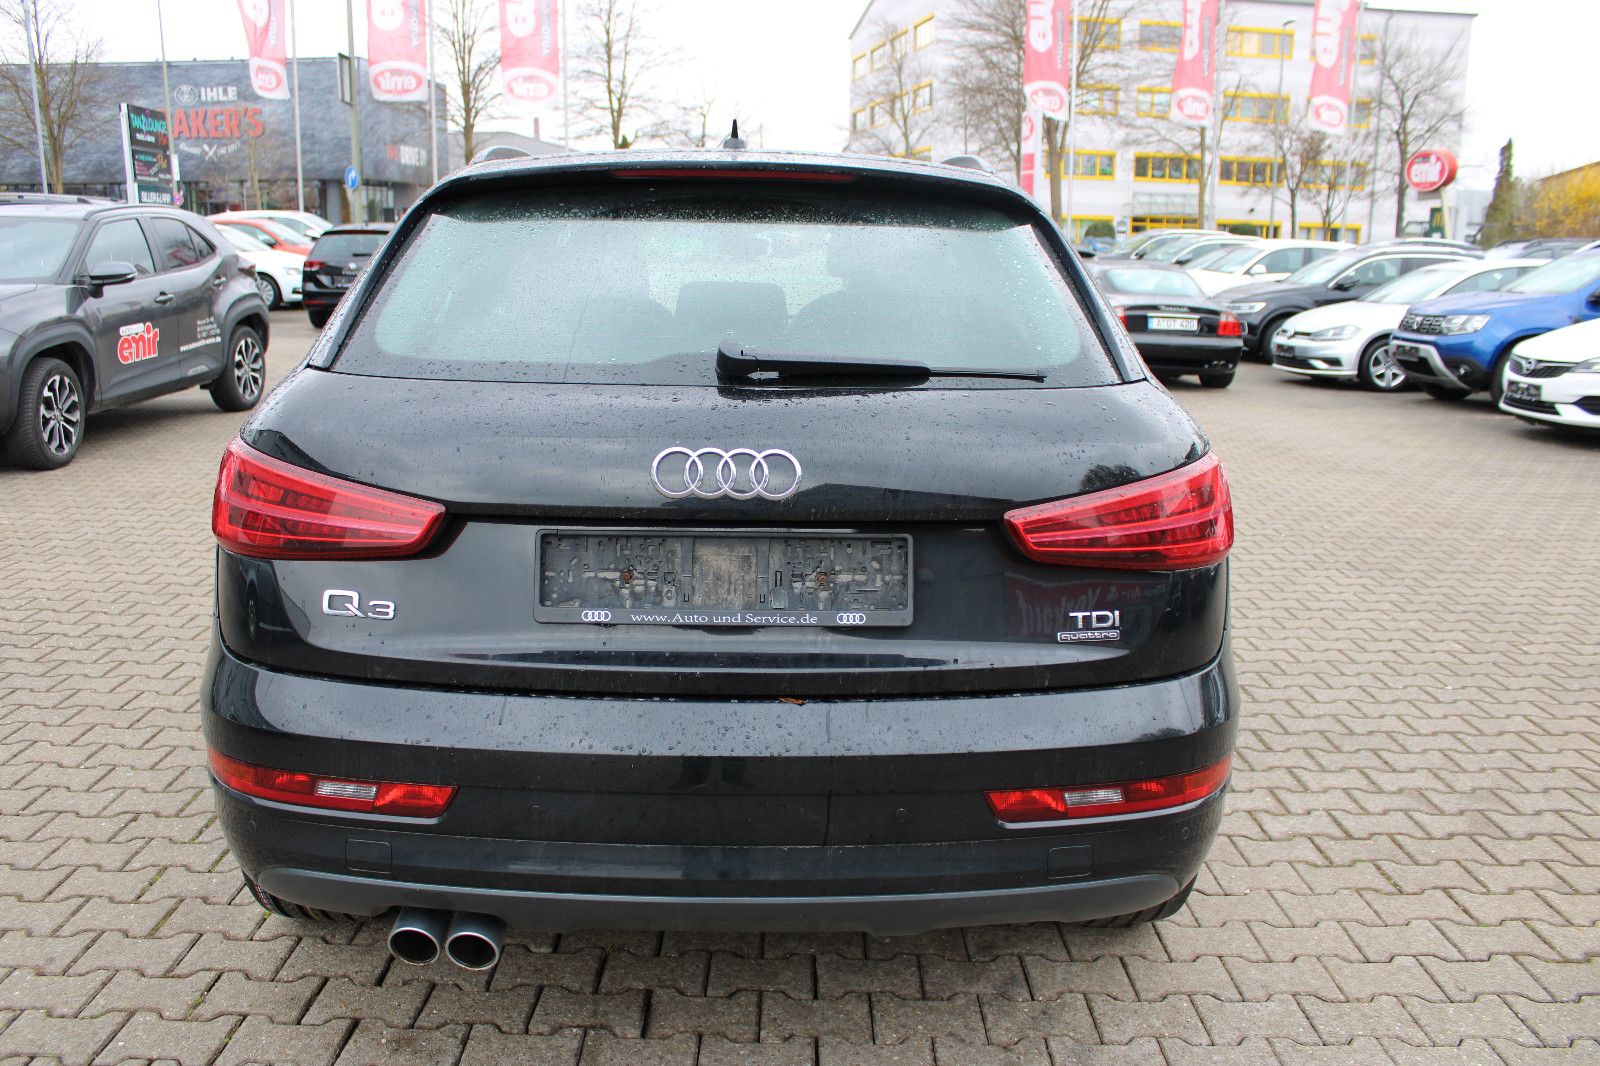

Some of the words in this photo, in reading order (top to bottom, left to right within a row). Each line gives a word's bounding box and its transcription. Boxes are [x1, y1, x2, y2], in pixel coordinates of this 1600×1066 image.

[200, 86, 238, 102] IHLE
[161, 106, 265, 140] AKER'S
[1409, 153, 1442, 184] emir
[118, 322, 159, 364] emir
[322, 589, 395, 620] Q3
[631, 613, 709, 623] www.Auto
[713, 613, 741, 623] und
[745, 613, 818, 624] Service.de
[1068, 609, 1120, 629] TDI
[1060, 632, 1118, 641] quattro
